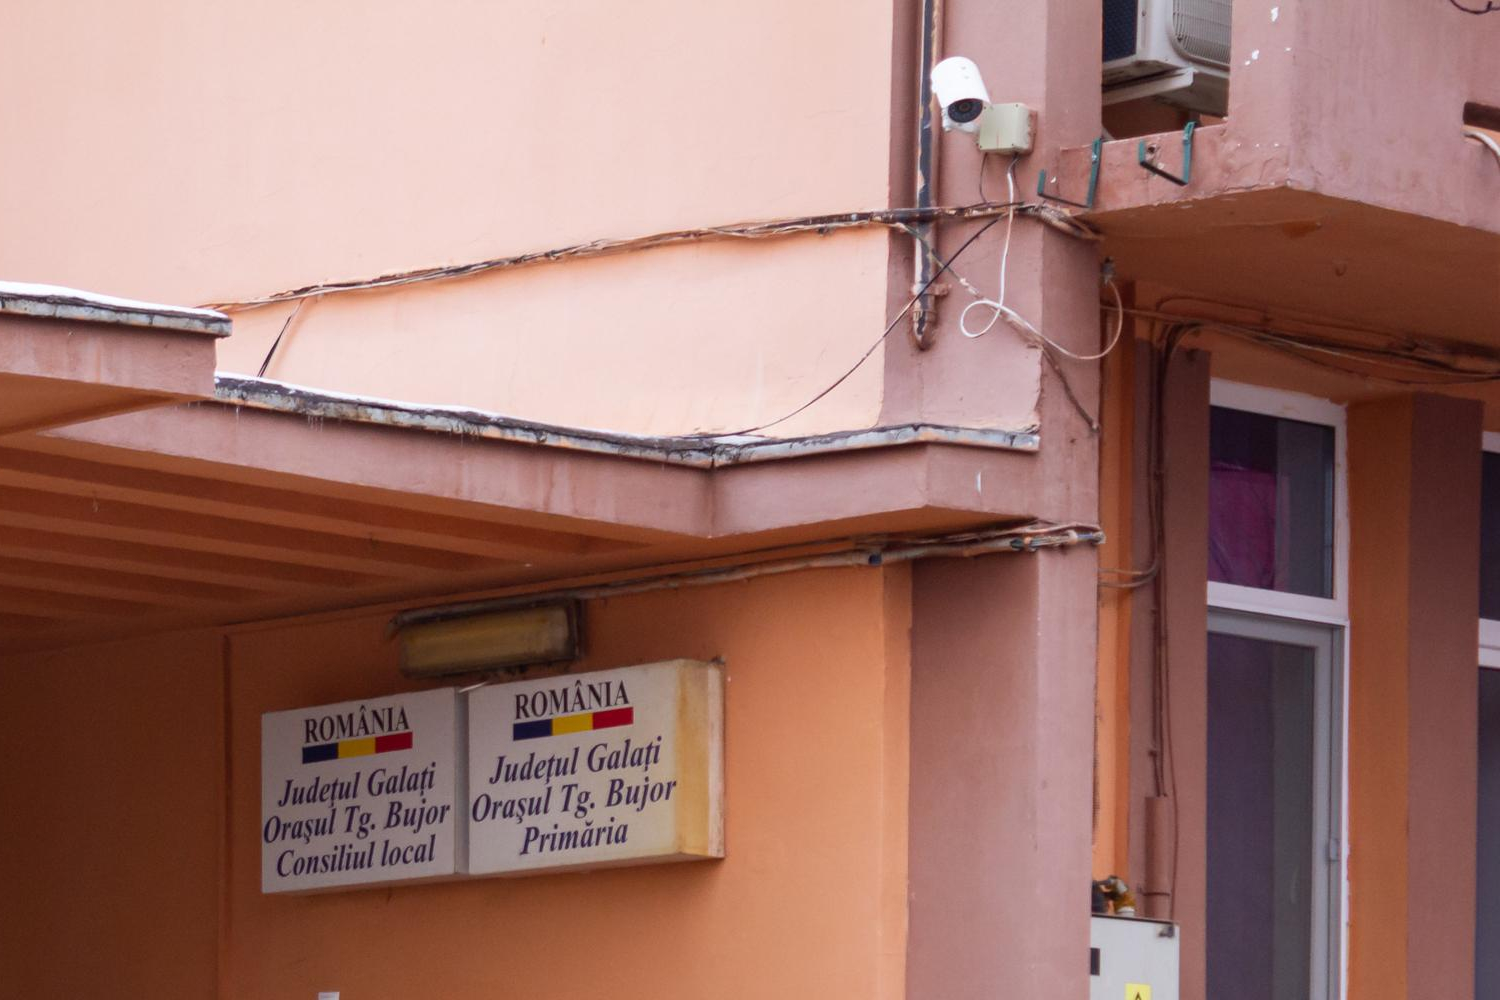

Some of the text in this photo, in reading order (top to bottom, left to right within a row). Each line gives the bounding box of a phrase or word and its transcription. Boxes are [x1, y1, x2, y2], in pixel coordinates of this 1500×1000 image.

[514, 679, 630, 720] ROMÂNIA
[304, 705, 410, 743] ROMÂNIA
[561, 783, 595, 819] Tg.
[605, 776, 677, 812] Bujor
[344, 805, 376, 840] Tg.
[384, 798, 451, 834] Bujor
[519, 816, 629, 856] Primăria
[277, 834, 436, 877] Consiliul local
